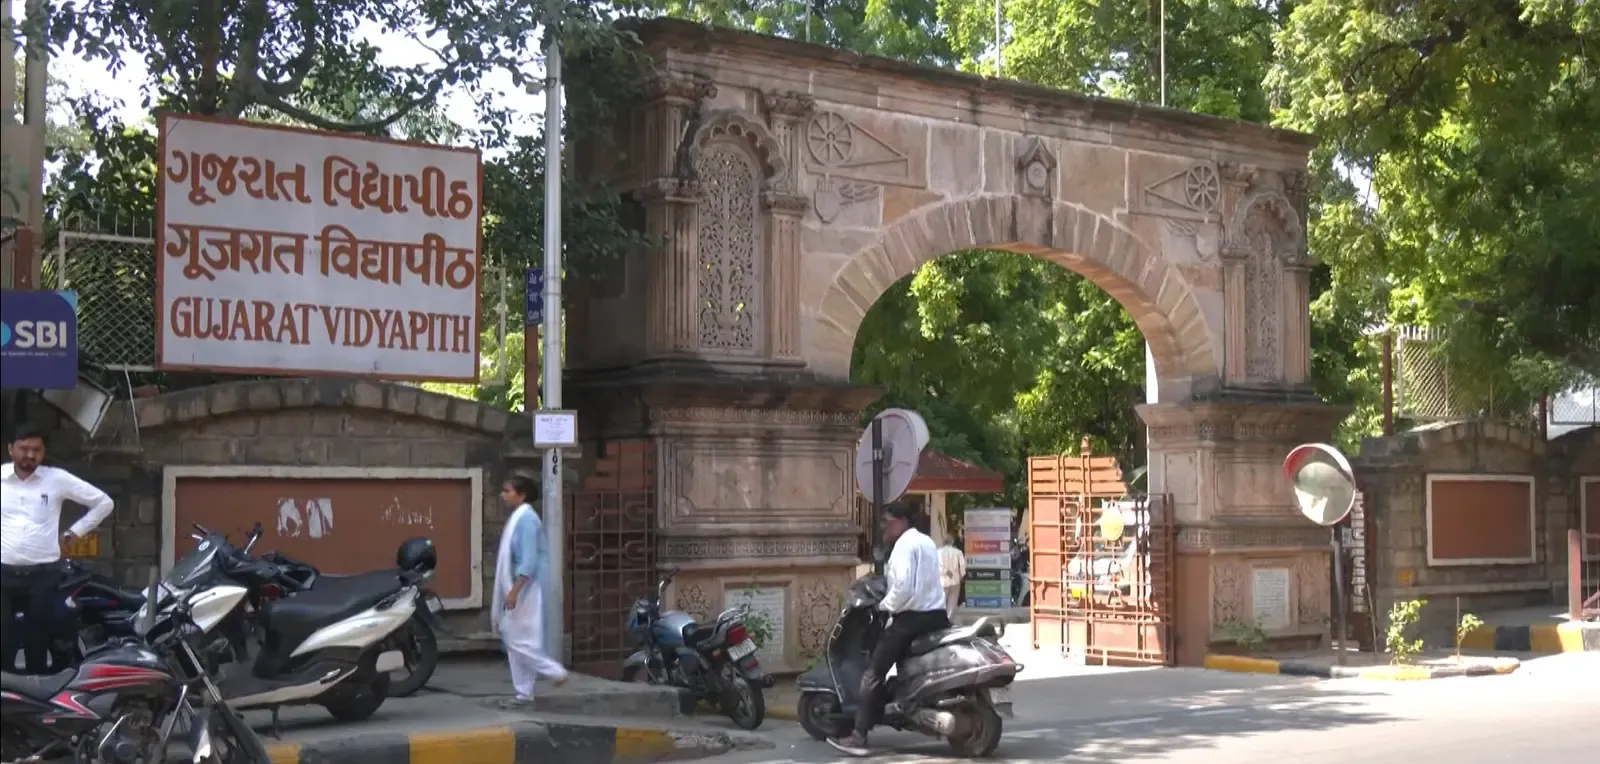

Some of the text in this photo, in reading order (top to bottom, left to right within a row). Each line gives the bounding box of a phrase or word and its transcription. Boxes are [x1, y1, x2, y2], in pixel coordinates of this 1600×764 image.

[166, 150, 312, 206] ગૂજરાત
[166, 222, 475, 289] गूजरात विद्यापीठ
[15, 321, 67, 348] SBI
[170, 296, 471, 353] GUJARAT VIDYAPITH
